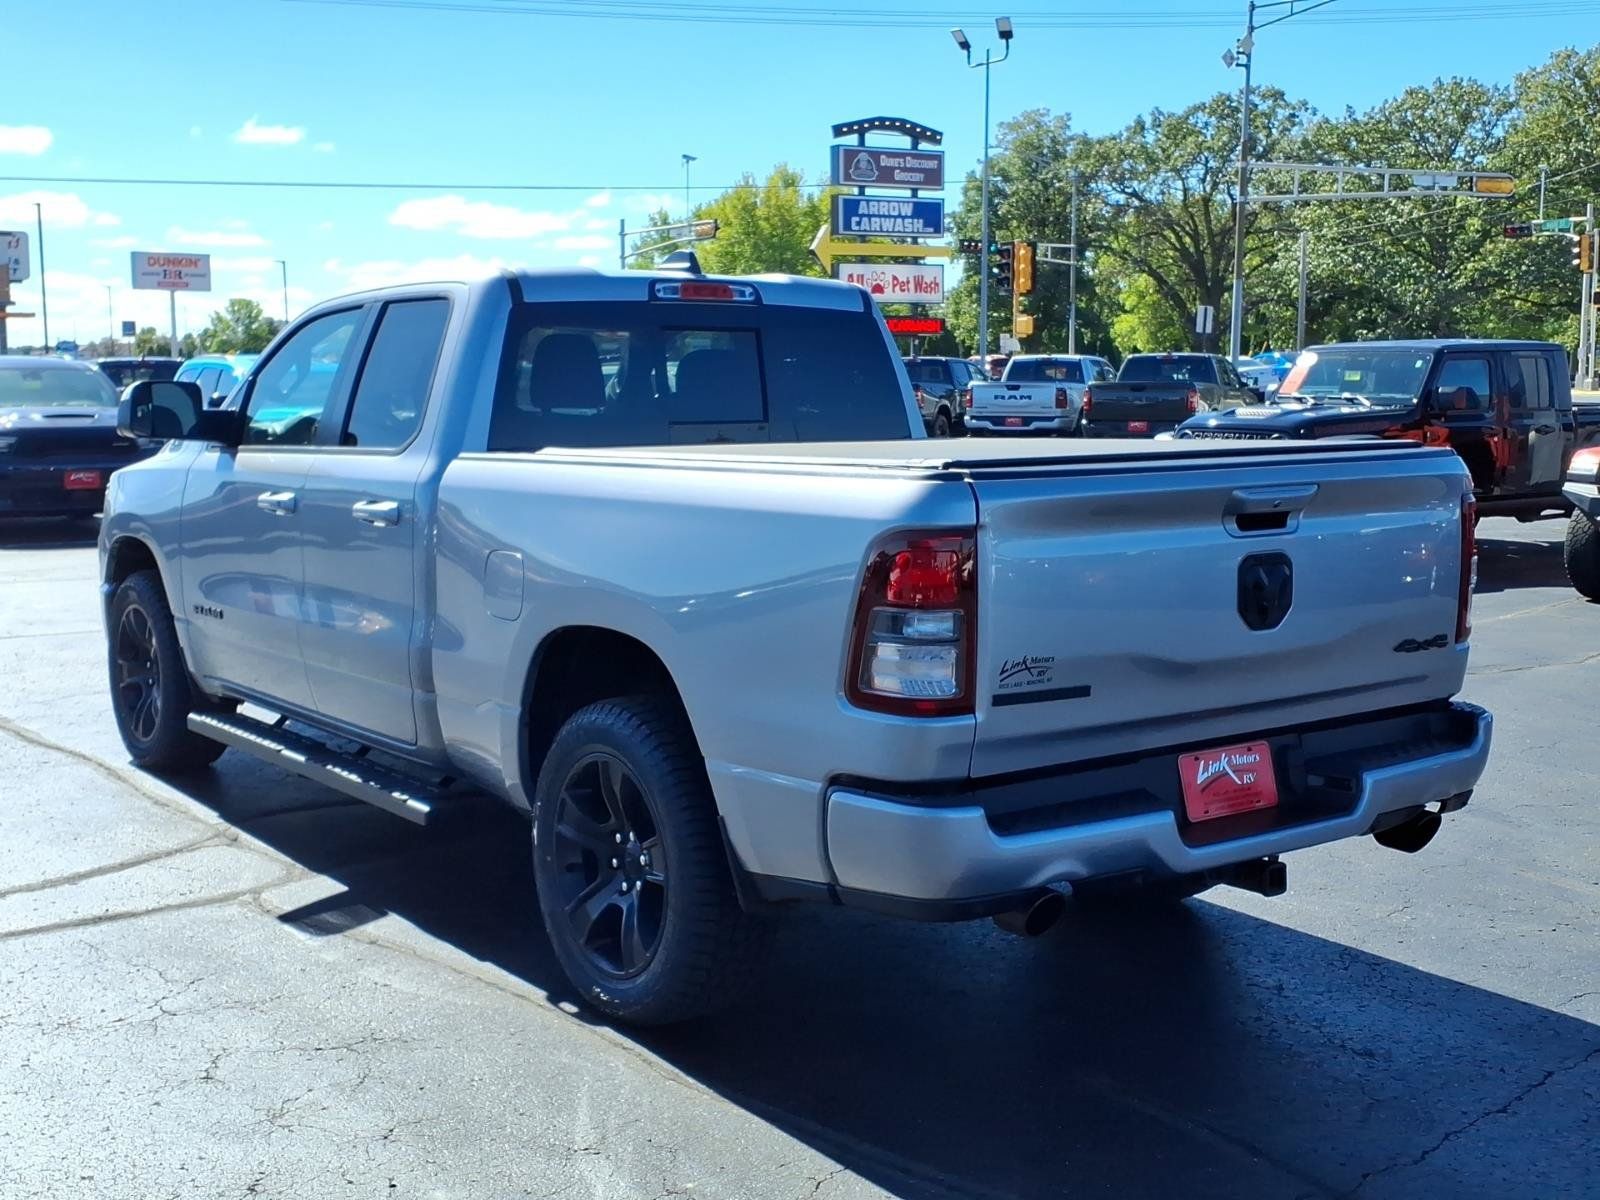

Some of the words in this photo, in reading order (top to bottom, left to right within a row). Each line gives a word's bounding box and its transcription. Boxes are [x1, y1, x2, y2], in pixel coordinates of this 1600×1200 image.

[905, 156, 939, 169] DISCOUNT
[894, 169, 925, 182] GROCERY
[857, 200, 914, 216] ARROW
[891, 274, 911, 294] Pet
[912, 274, 940, 295] Wash
[999, 655, 1034, 677] Link
[1030, 655, 1055, 665] Motors
[1196, 752, 1243, 785] Link
[1230, 753, 1261, 766] Motors
[1242, 771, 1258, 785] RV
